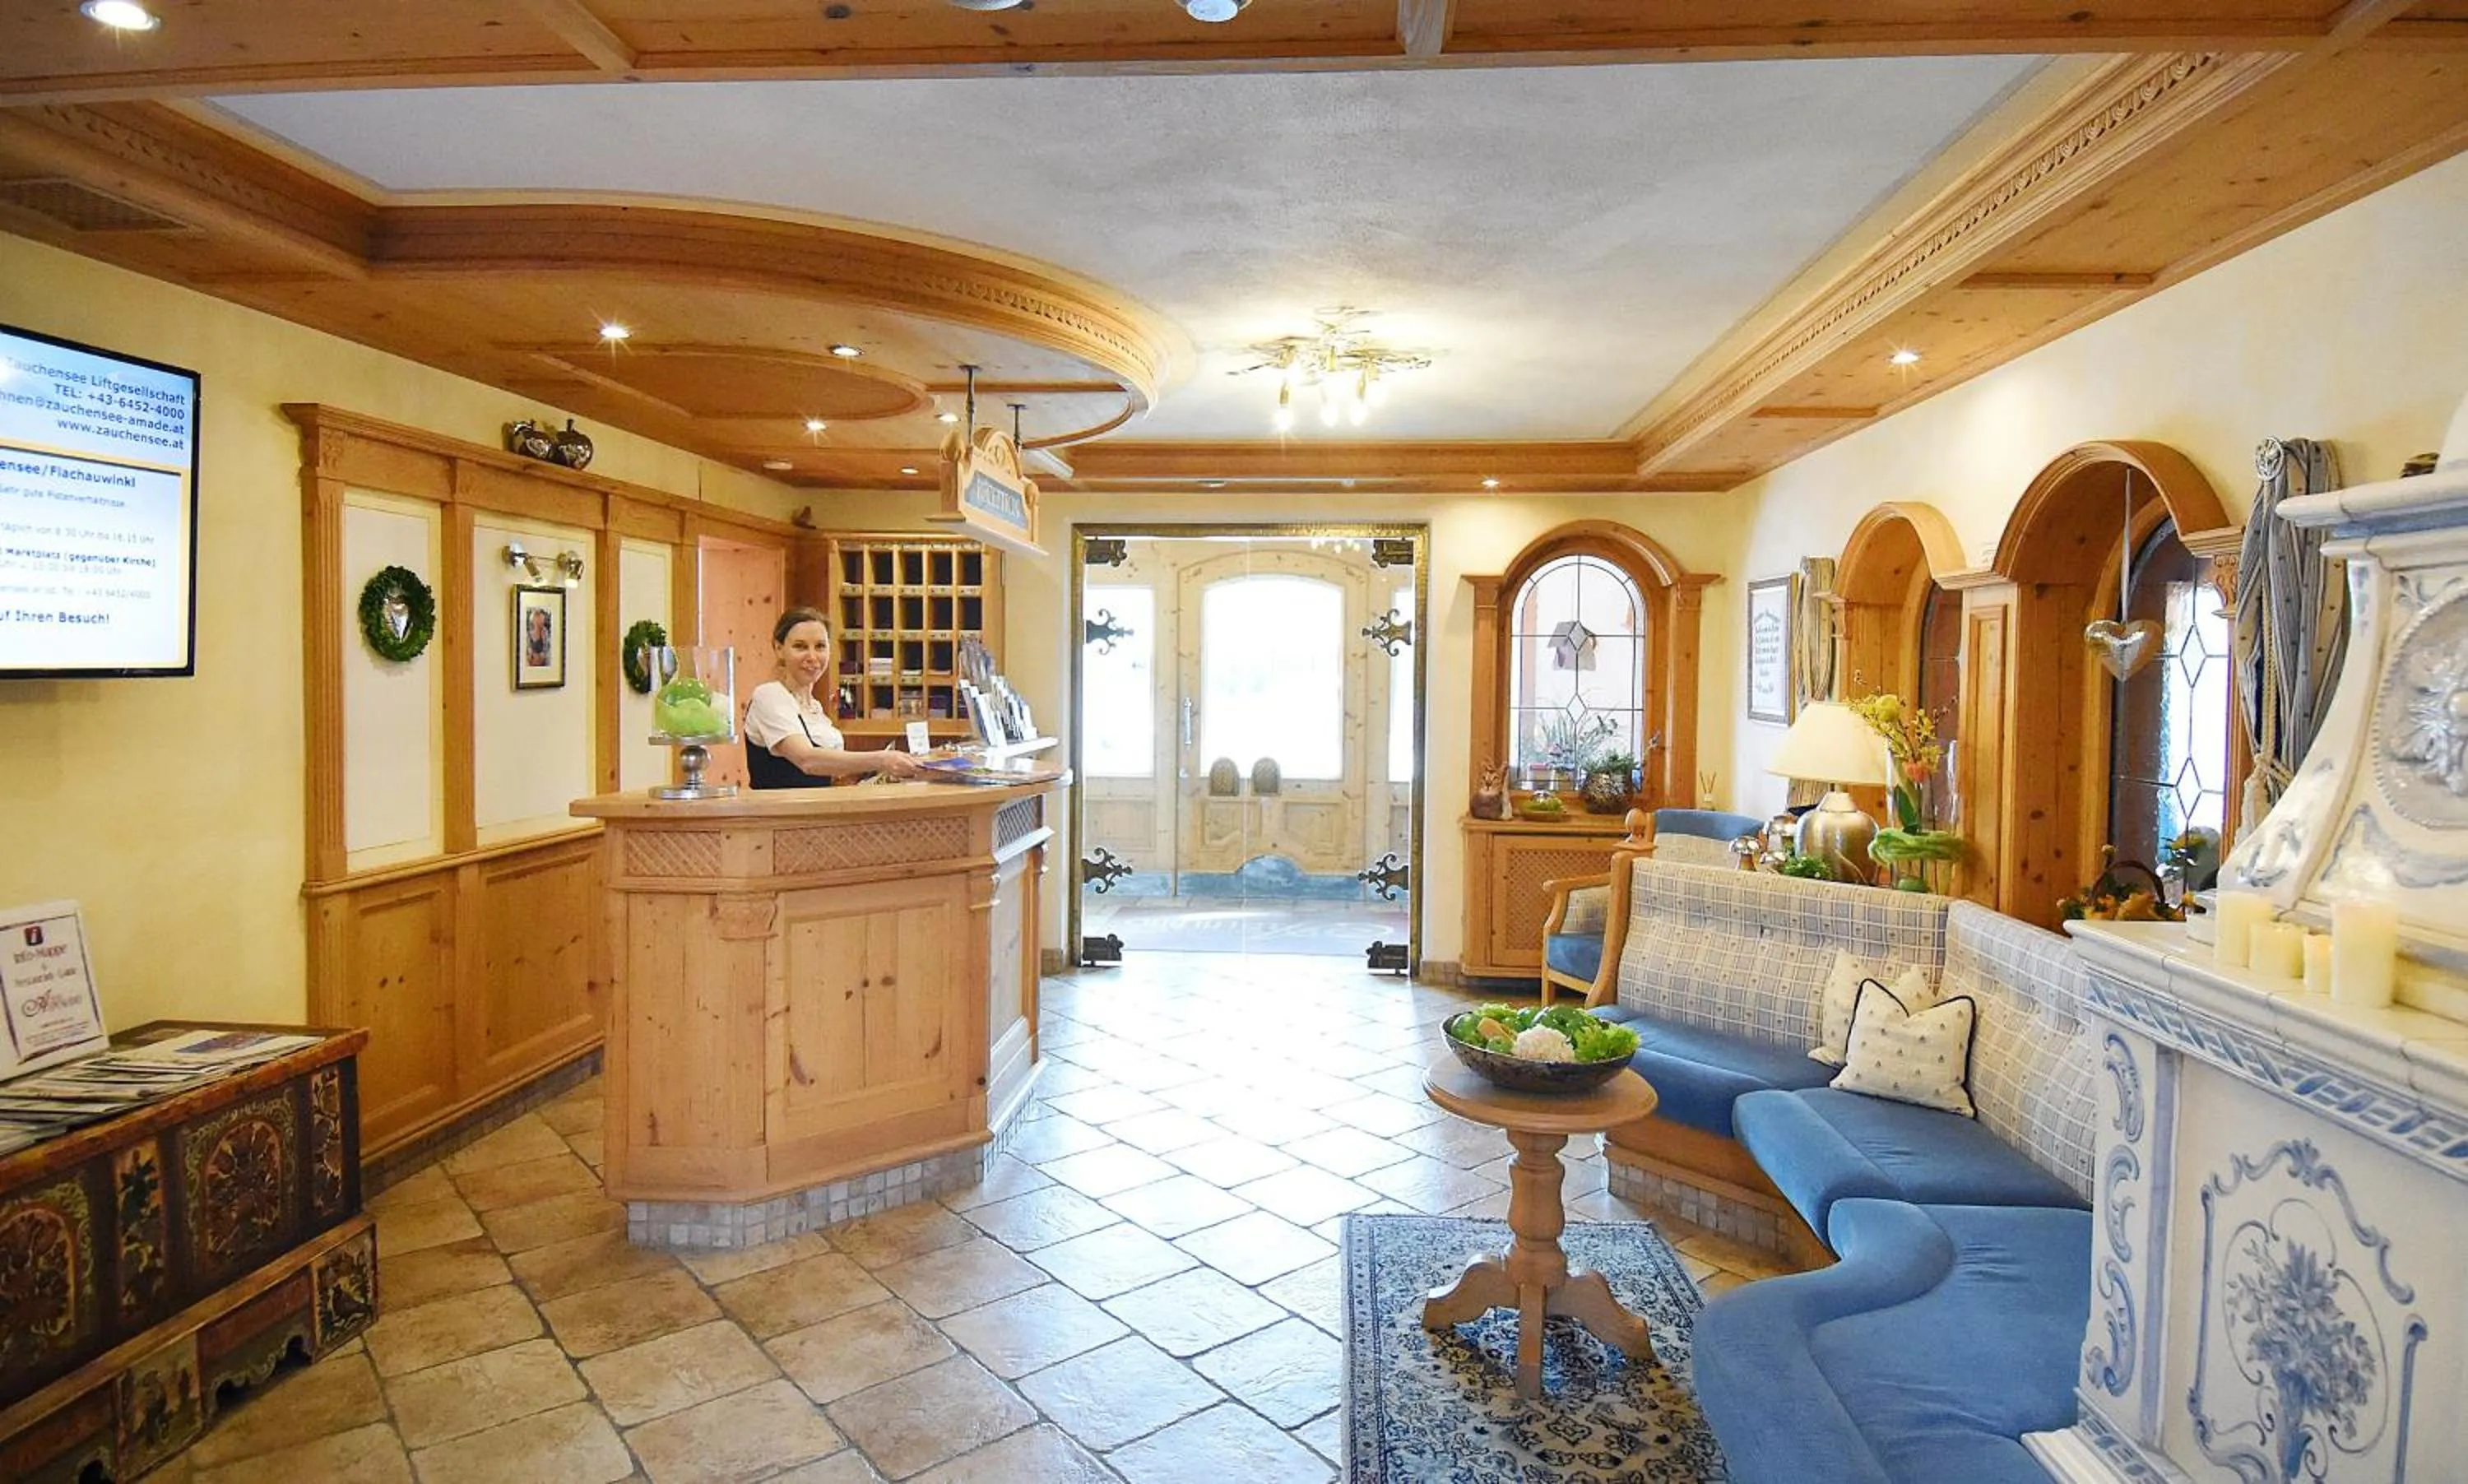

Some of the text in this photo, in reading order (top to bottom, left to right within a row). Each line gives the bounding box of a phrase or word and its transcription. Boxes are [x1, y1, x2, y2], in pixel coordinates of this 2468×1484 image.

[53, 383, 185, 420] TEL: +43-6452-4000
[91, 375, 185, 406] Liftgesellschaft
[57, 420, 184, 450] www.zauchensee.at
[16, 610, 53, 623] Ihren
[58, 611, 110, 625] Besuch!
